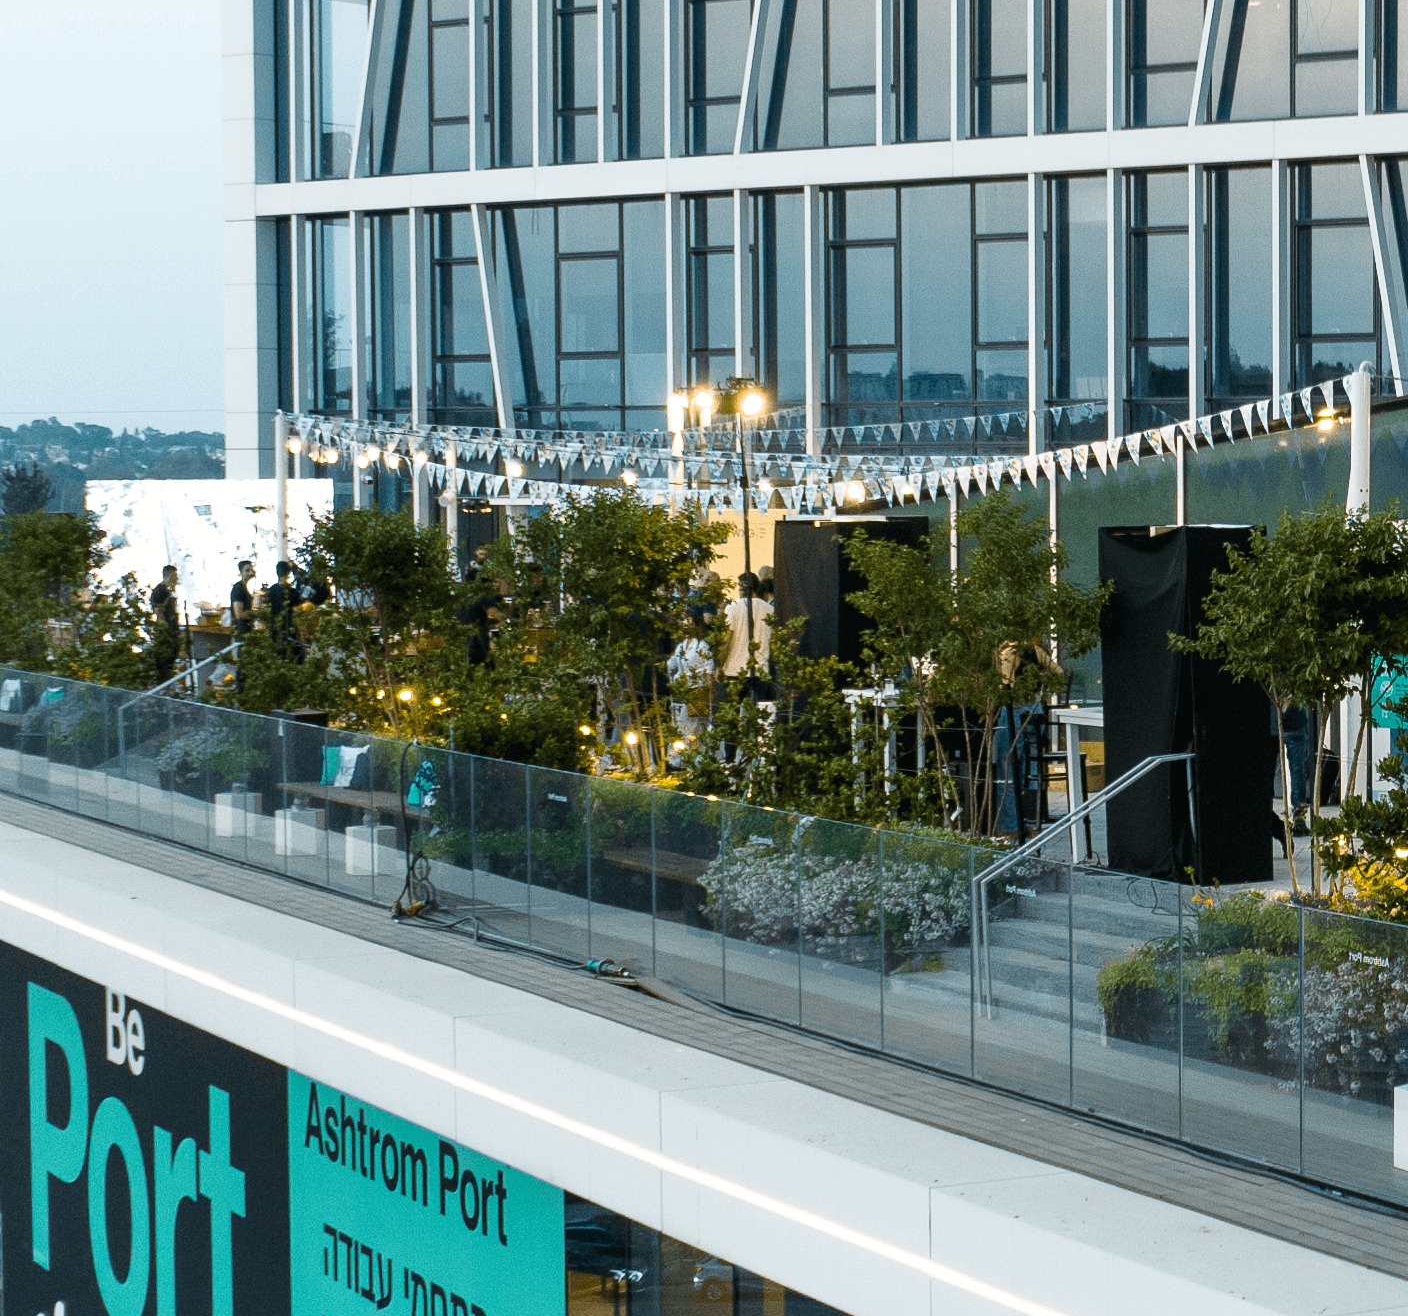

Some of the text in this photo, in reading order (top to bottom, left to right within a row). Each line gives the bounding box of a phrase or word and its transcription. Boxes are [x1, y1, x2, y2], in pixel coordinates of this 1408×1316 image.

[105, 986, 146, 1077] Be
[304, 1081, 508, 1247] Ashtrom Port
[323, 1222, 393, 1312] עבודה
